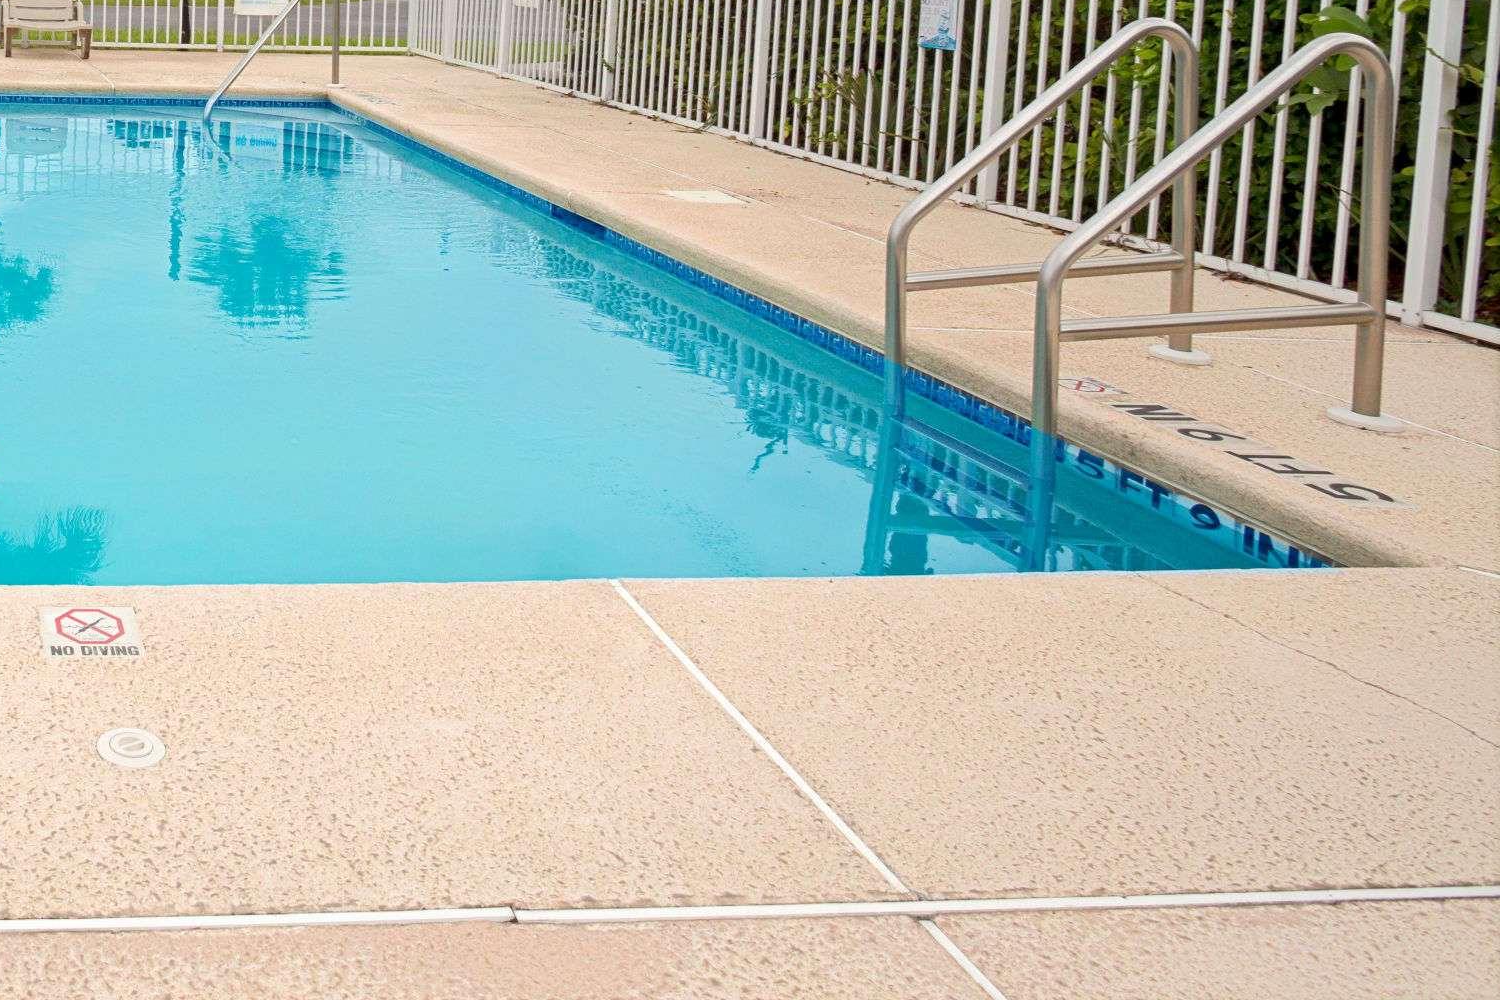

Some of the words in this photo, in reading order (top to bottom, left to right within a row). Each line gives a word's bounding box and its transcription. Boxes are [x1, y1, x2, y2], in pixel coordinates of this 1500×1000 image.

[1111, 403, 1199, 422] IN
[1223, 450, 1335, 476] FT
[1304, 482, 1396, 503] 5
[1118, 467, 1171, 510] FT
[1189, 503, 1221, 531] 9
[1243, 525, 1300, 568] IN
[50, 645, 75, 656] NO
[80, 645, 140, 656] DIVING
